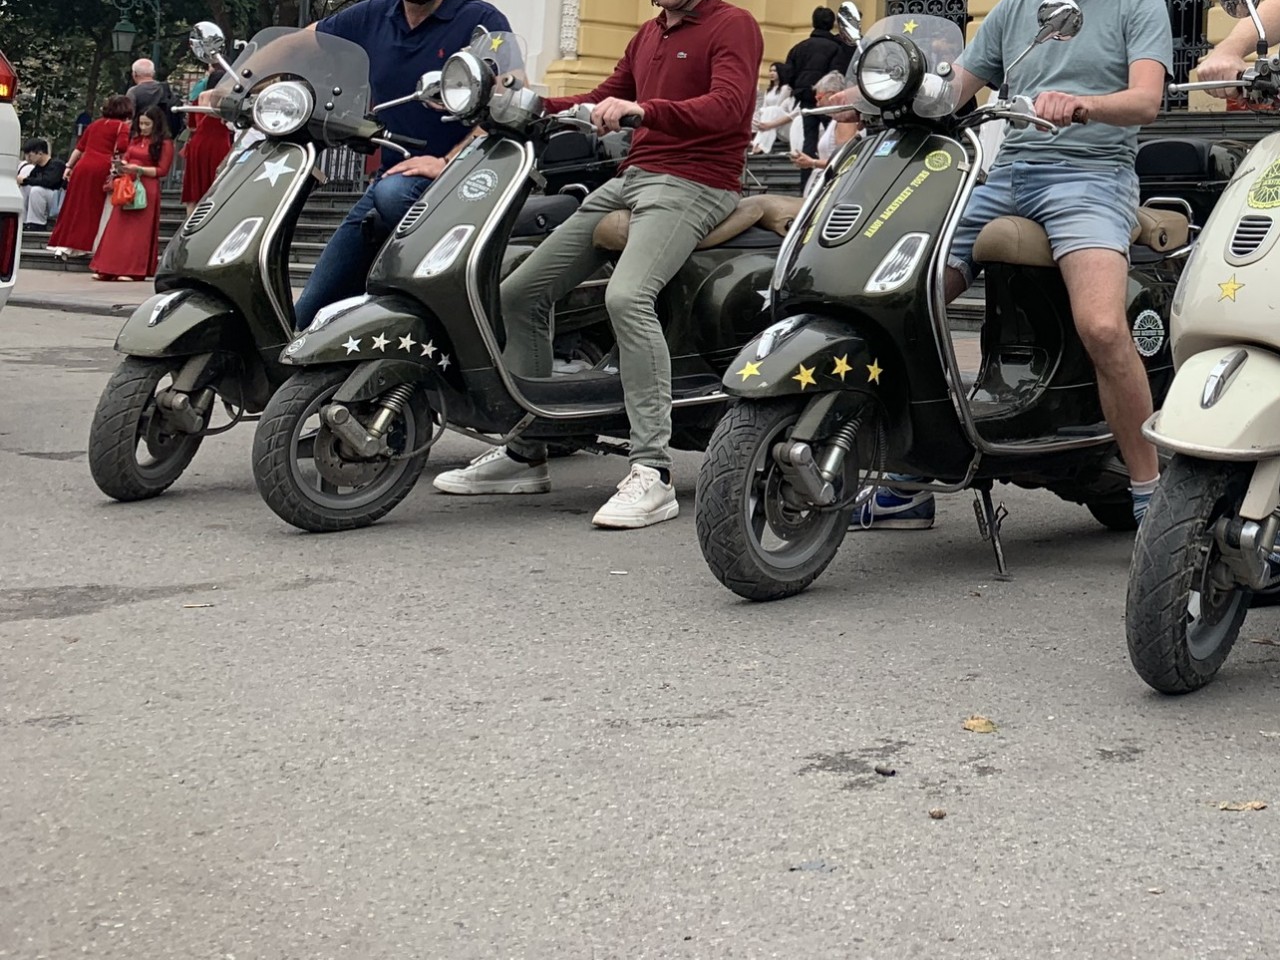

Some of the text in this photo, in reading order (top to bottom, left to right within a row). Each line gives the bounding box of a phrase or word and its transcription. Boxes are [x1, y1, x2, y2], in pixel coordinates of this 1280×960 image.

[863, 169, 930, 238] HANOI BACKSTREET TOURS
